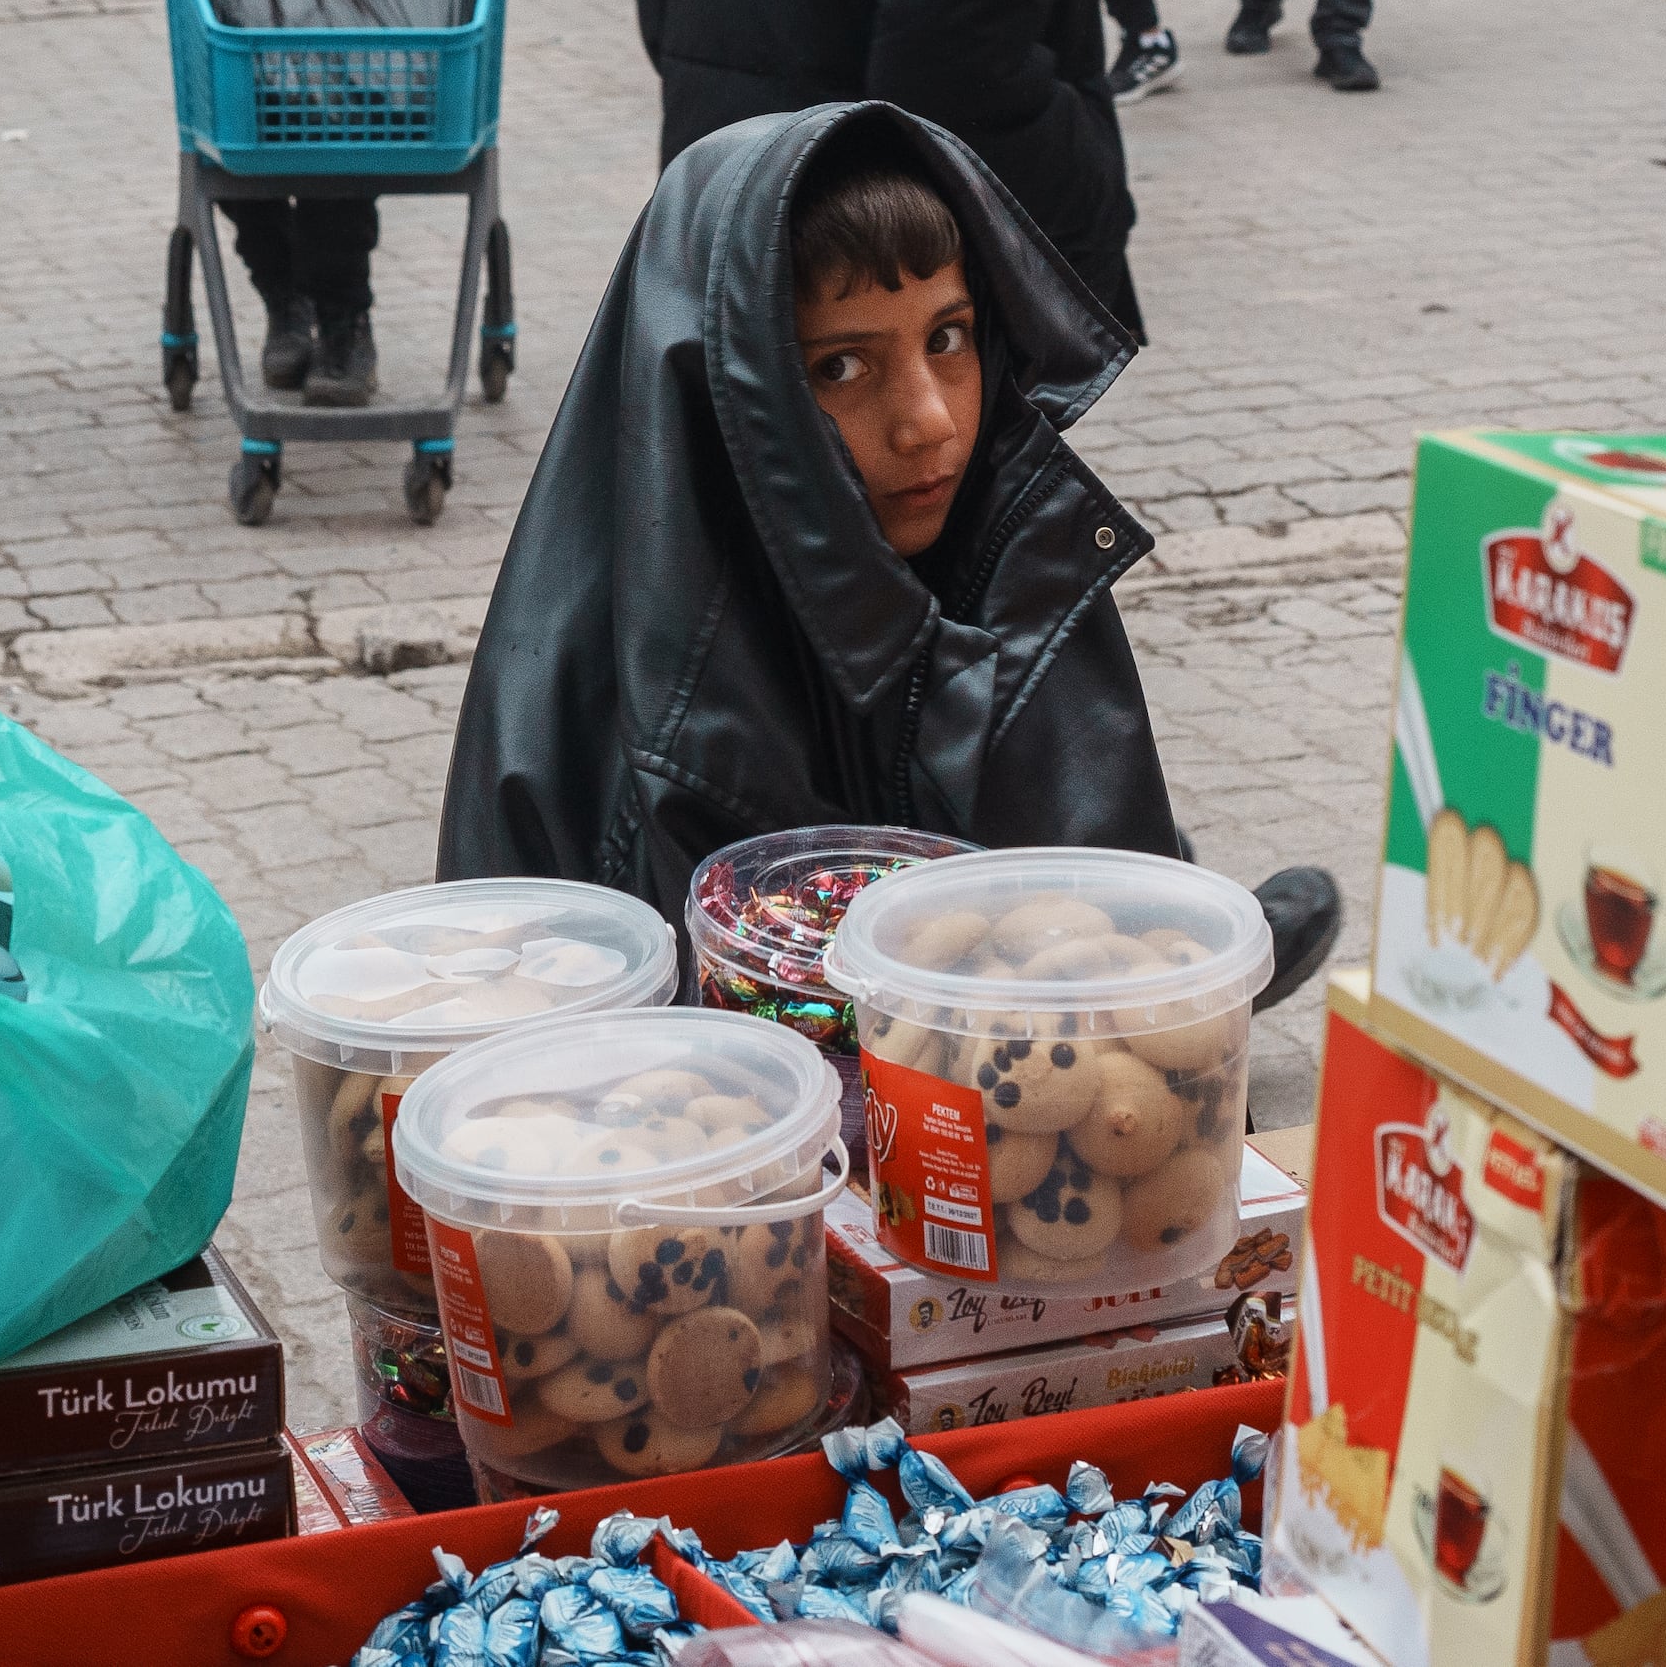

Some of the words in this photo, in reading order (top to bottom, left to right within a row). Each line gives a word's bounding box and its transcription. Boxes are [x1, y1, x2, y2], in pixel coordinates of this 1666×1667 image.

[1484, 660, 1615, 770] FİNGER
[37, 1379, 115, 1420] Türk
[124, 1371, 258, 1410] Lokumu
[47, 1483, 125, 1527] Türk
[133, 1475, 268, 1515] Lokumu
